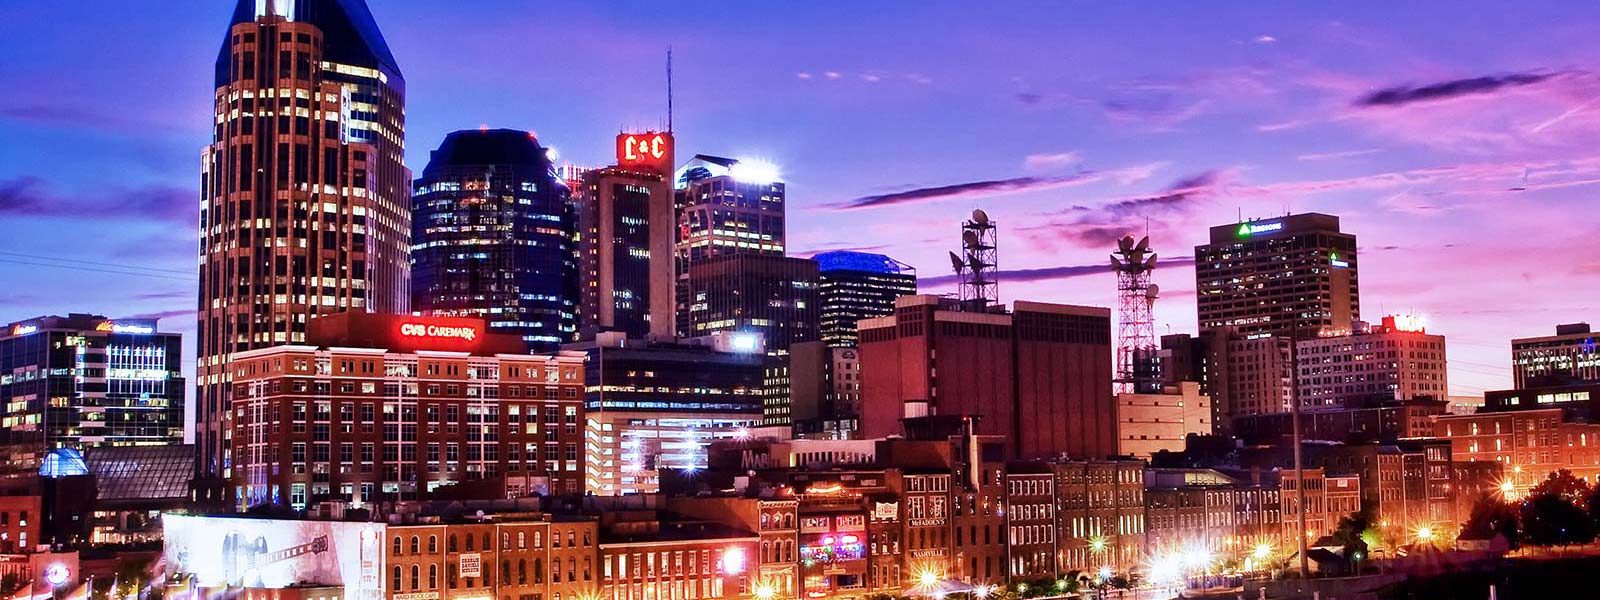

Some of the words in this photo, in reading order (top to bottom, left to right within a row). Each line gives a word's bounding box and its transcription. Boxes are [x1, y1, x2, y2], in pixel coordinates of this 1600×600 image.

[638, 139, 649, 154] &
[651, 135, 664, 159] C
[401, 323, 426, 336] CVS
[427, 325, 476, 340] CAREMARK
[912, 550, 943, 558] NASHVILLE
